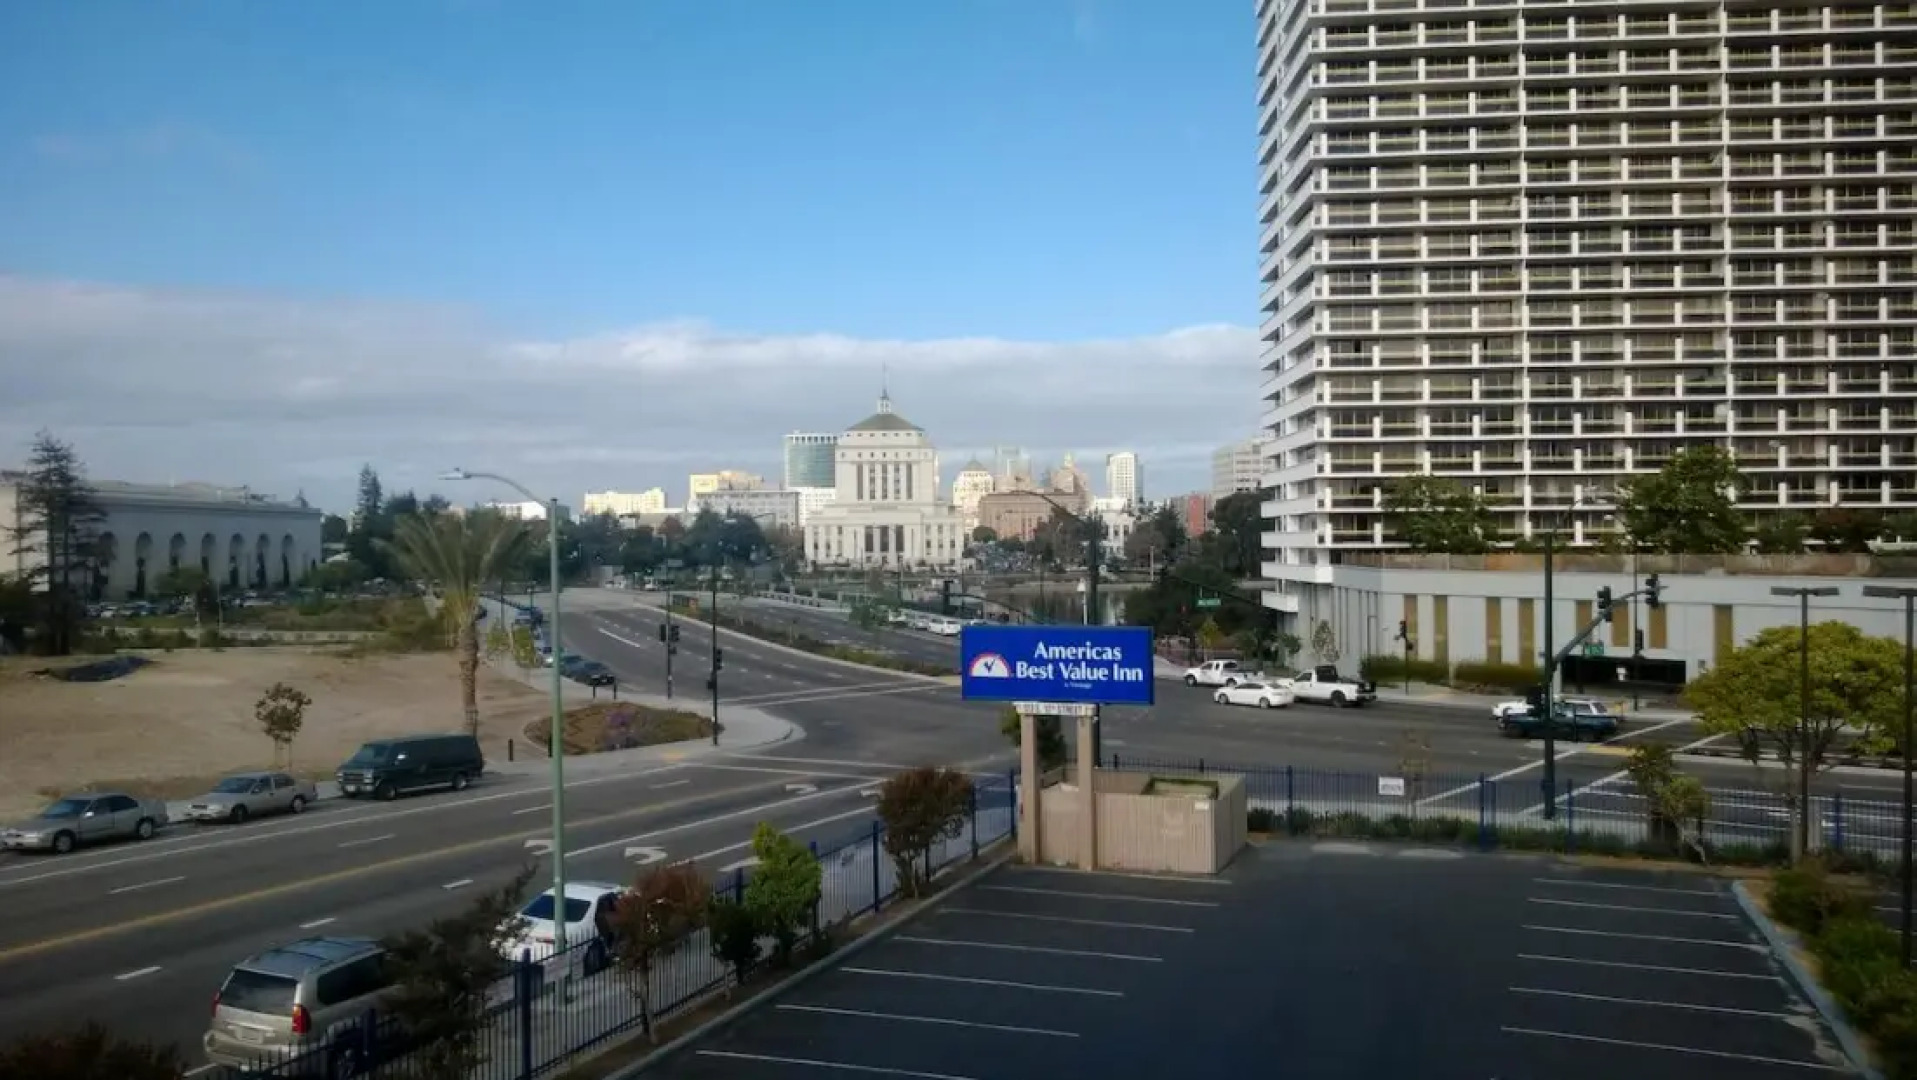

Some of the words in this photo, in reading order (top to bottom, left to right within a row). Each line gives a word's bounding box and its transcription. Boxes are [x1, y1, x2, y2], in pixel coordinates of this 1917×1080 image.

[1034, 640, 1122, 660] Americas
[1015, 661, 1053, 680] Best
[1059, 661, 1108, 681] Value
[1113, 663, 1143, 682] Inn
